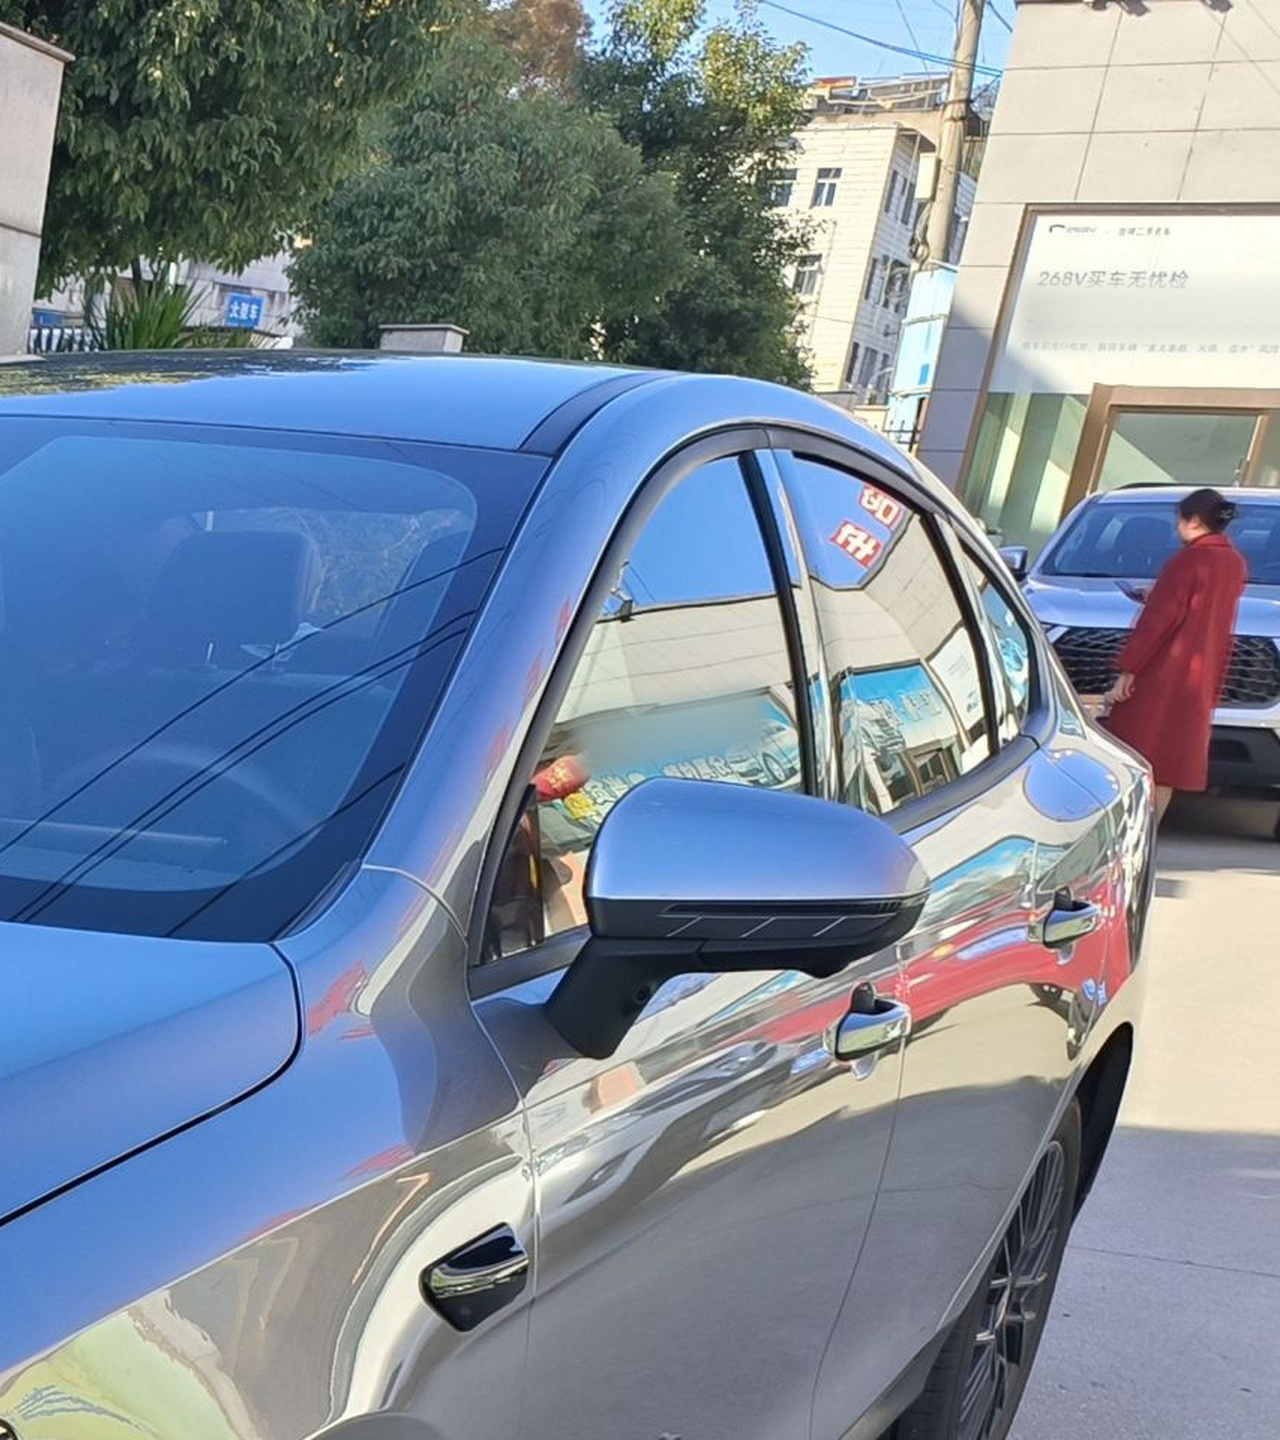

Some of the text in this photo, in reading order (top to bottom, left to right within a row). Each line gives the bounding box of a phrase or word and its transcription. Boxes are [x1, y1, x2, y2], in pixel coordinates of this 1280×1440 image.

[1037, 270, 1190, 289] 268V买车无忧检
